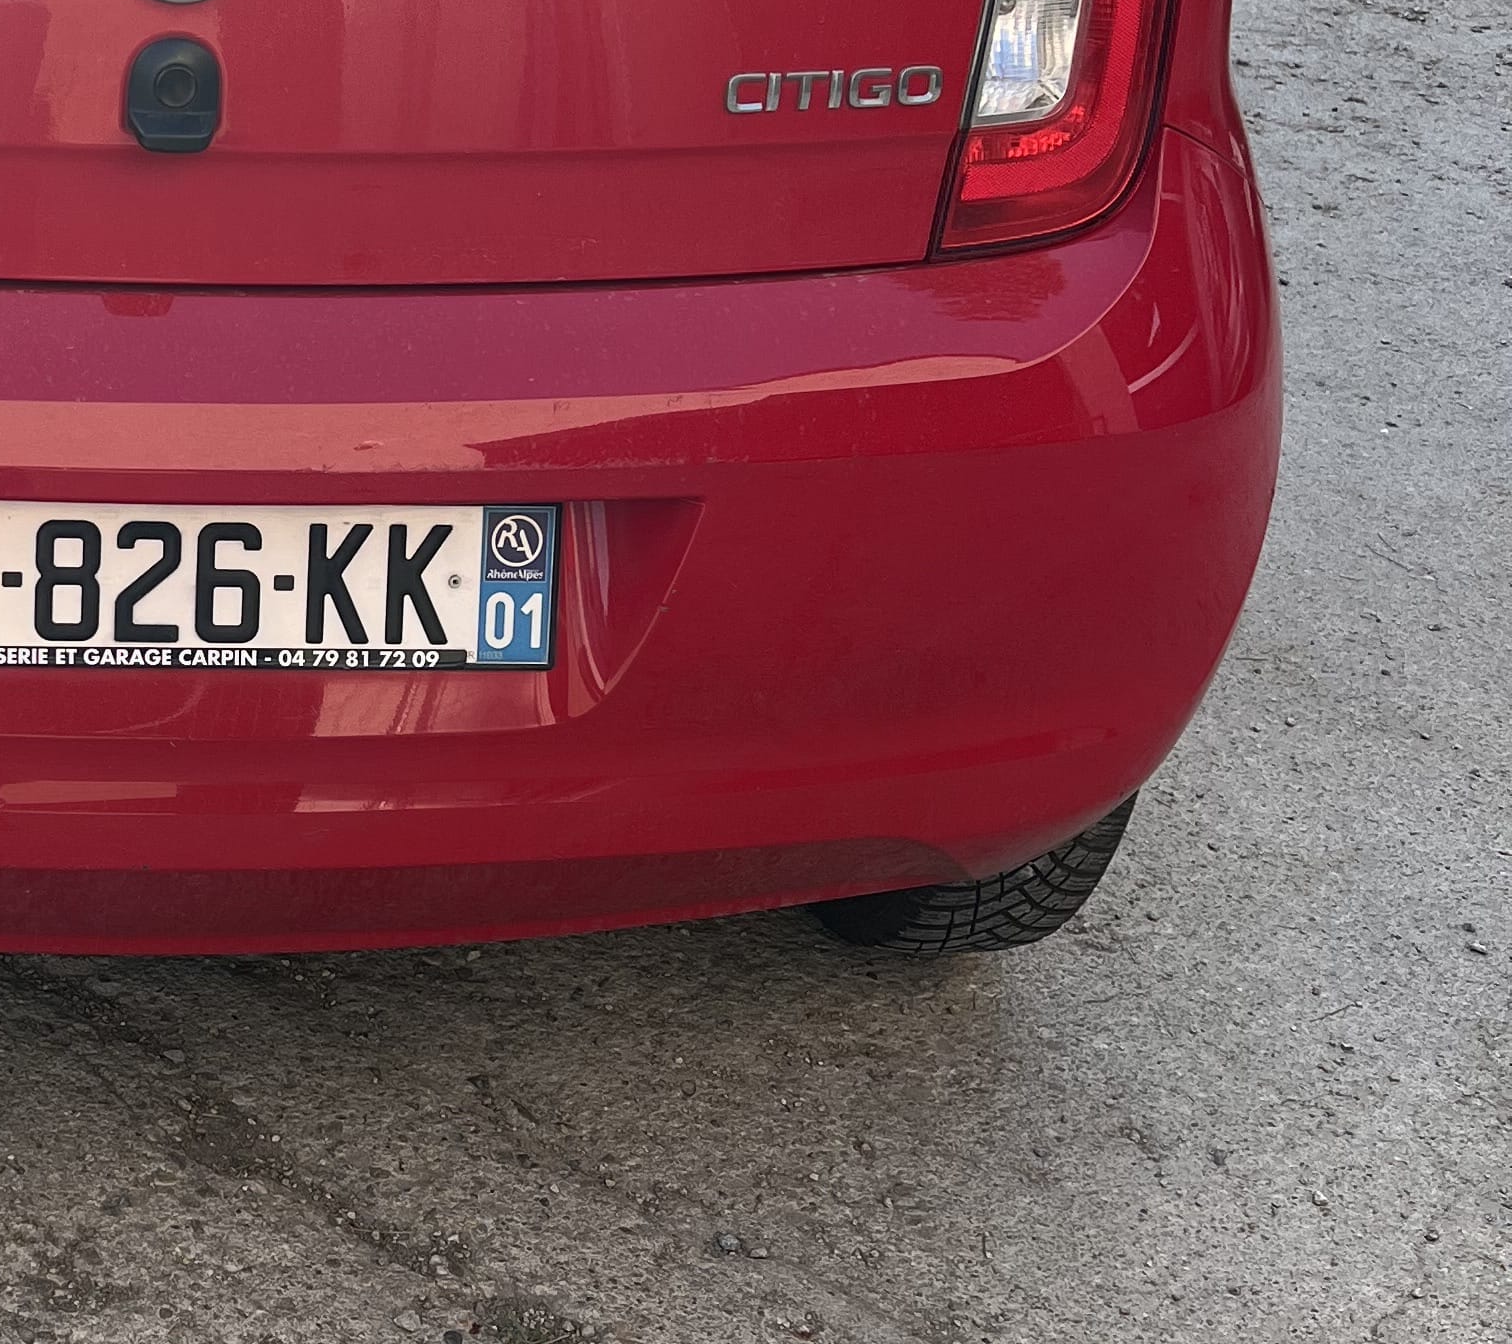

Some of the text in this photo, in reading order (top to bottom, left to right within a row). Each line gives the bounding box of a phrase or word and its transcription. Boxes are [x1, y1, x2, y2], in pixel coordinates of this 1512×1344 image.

[726, 65, 944, 113] CITIGO
[484, 591, 543, 650] 01
[55, 648, 78, 665] ET
[83, 648, 172, 666] GARAGE
[179, 649, 257, 667] CARPIN
[278, 650, 306, 667] 04
[312, 650, 339, 667] 79
[345, 650, 370, 667] 81
[379, 651, 406, 667] 72
[412, 651, 440, 668] 09
